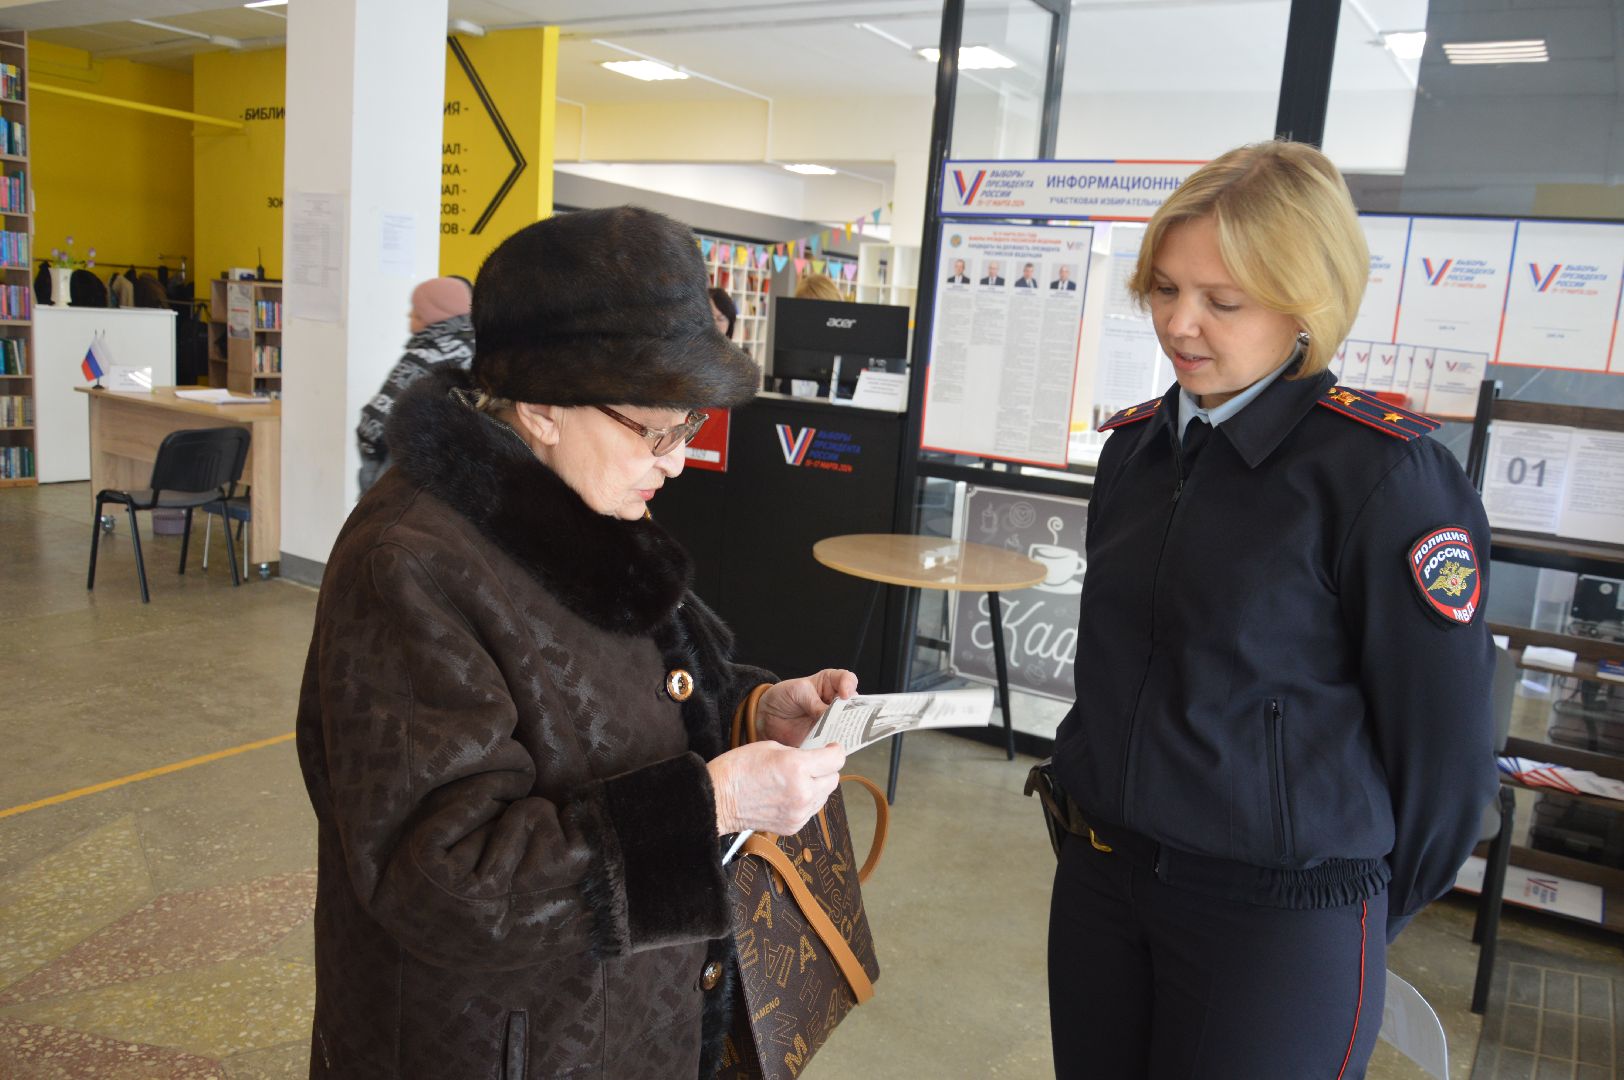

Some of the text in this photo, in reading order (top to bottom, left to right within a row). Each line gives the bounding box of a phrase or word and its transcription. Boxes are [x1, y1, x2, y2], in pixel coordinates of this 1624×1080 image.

[245, 106, 285, 120] БИБЛИ
[826, 317, 857, 329] acer
[1506, 457, 1547, 488] 01
[1414, 531, 1469, 565] ПОЛИЦИЯ
[1423, 547, 1471, 580] РОССИЯ
[1452, 601, 1475, 622] МВД
